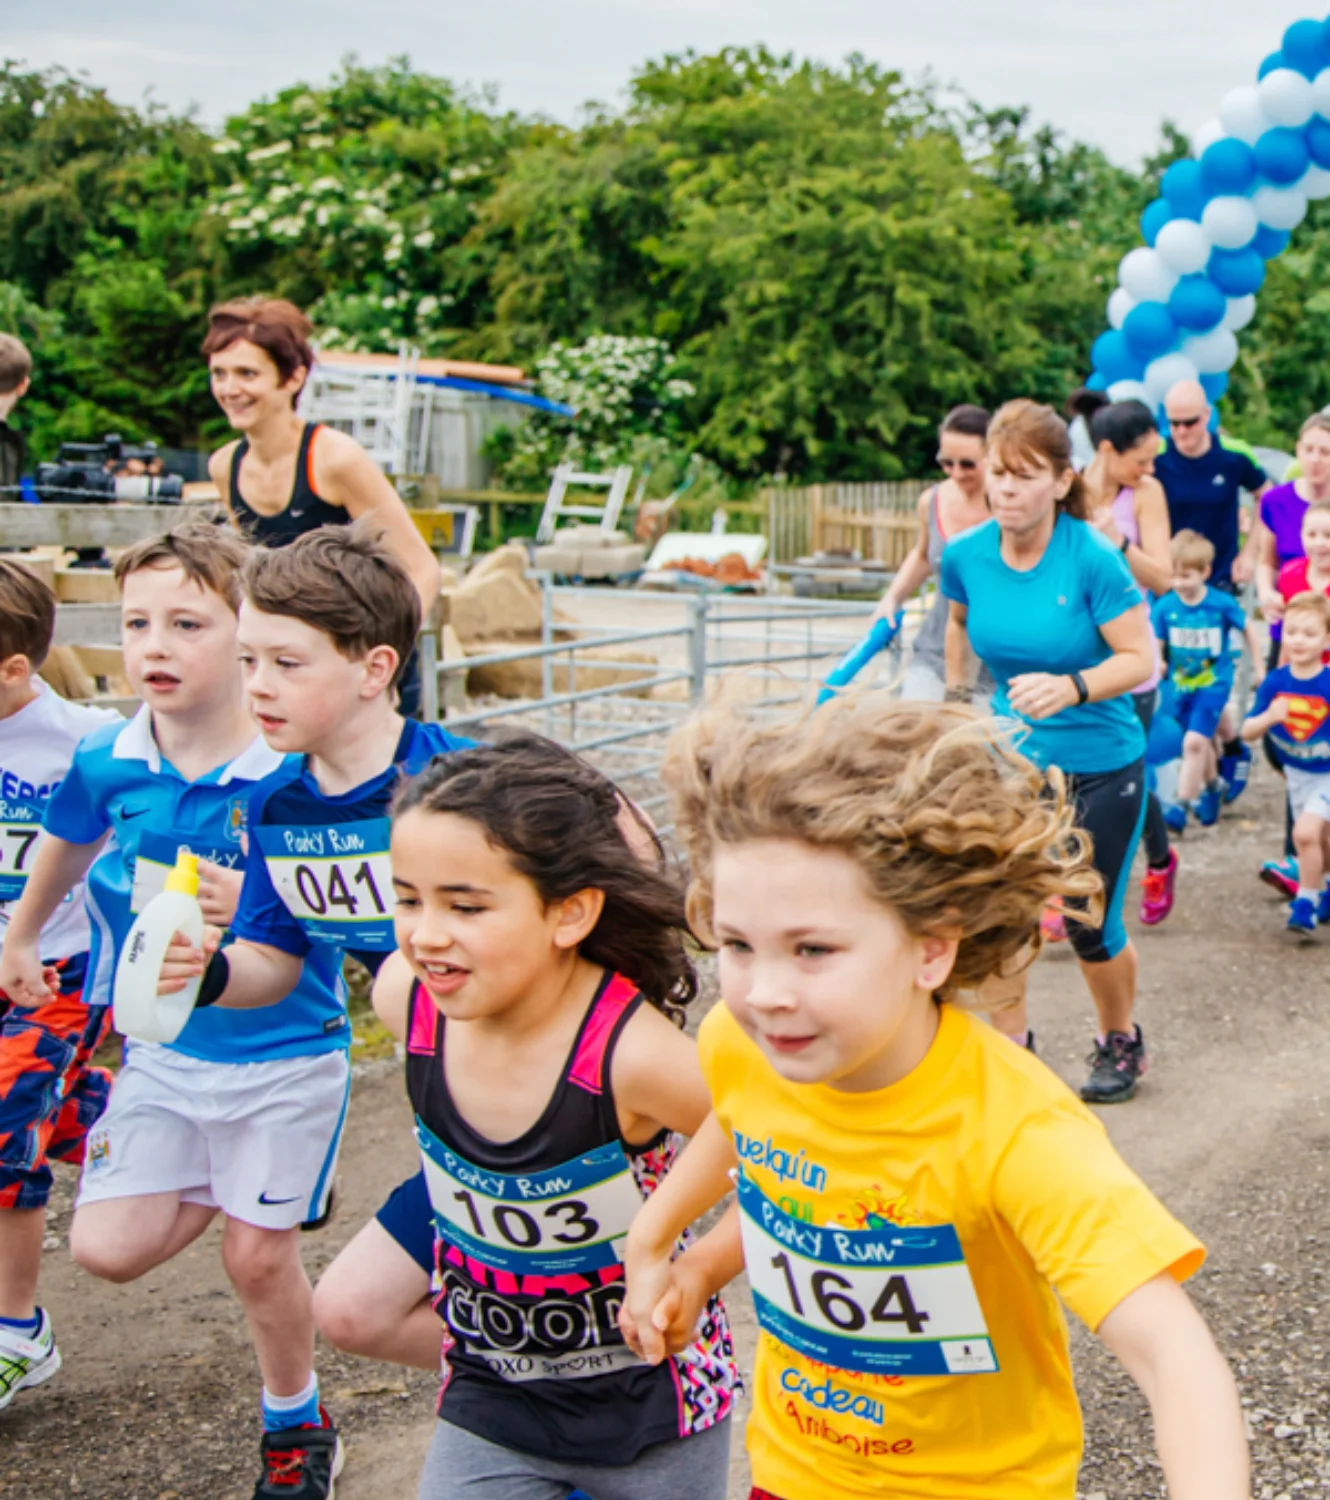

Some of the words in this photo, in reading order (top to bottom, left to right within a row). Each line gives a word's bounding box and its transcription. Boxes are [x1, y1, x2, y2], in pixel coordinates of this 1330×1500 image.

[0, 829, 38, 870] 7
[327, 828, 364, 853] Run
[295, 861, 386, 915] 041
[733, 1129, 827, 1194] uelqu'un
[516, 1177, 572, 1199] Run
[453, 1190, 600, 1248] 103
[833, 1233, 896, 1262] Run
[770, 1252, 930, 1334] 164
